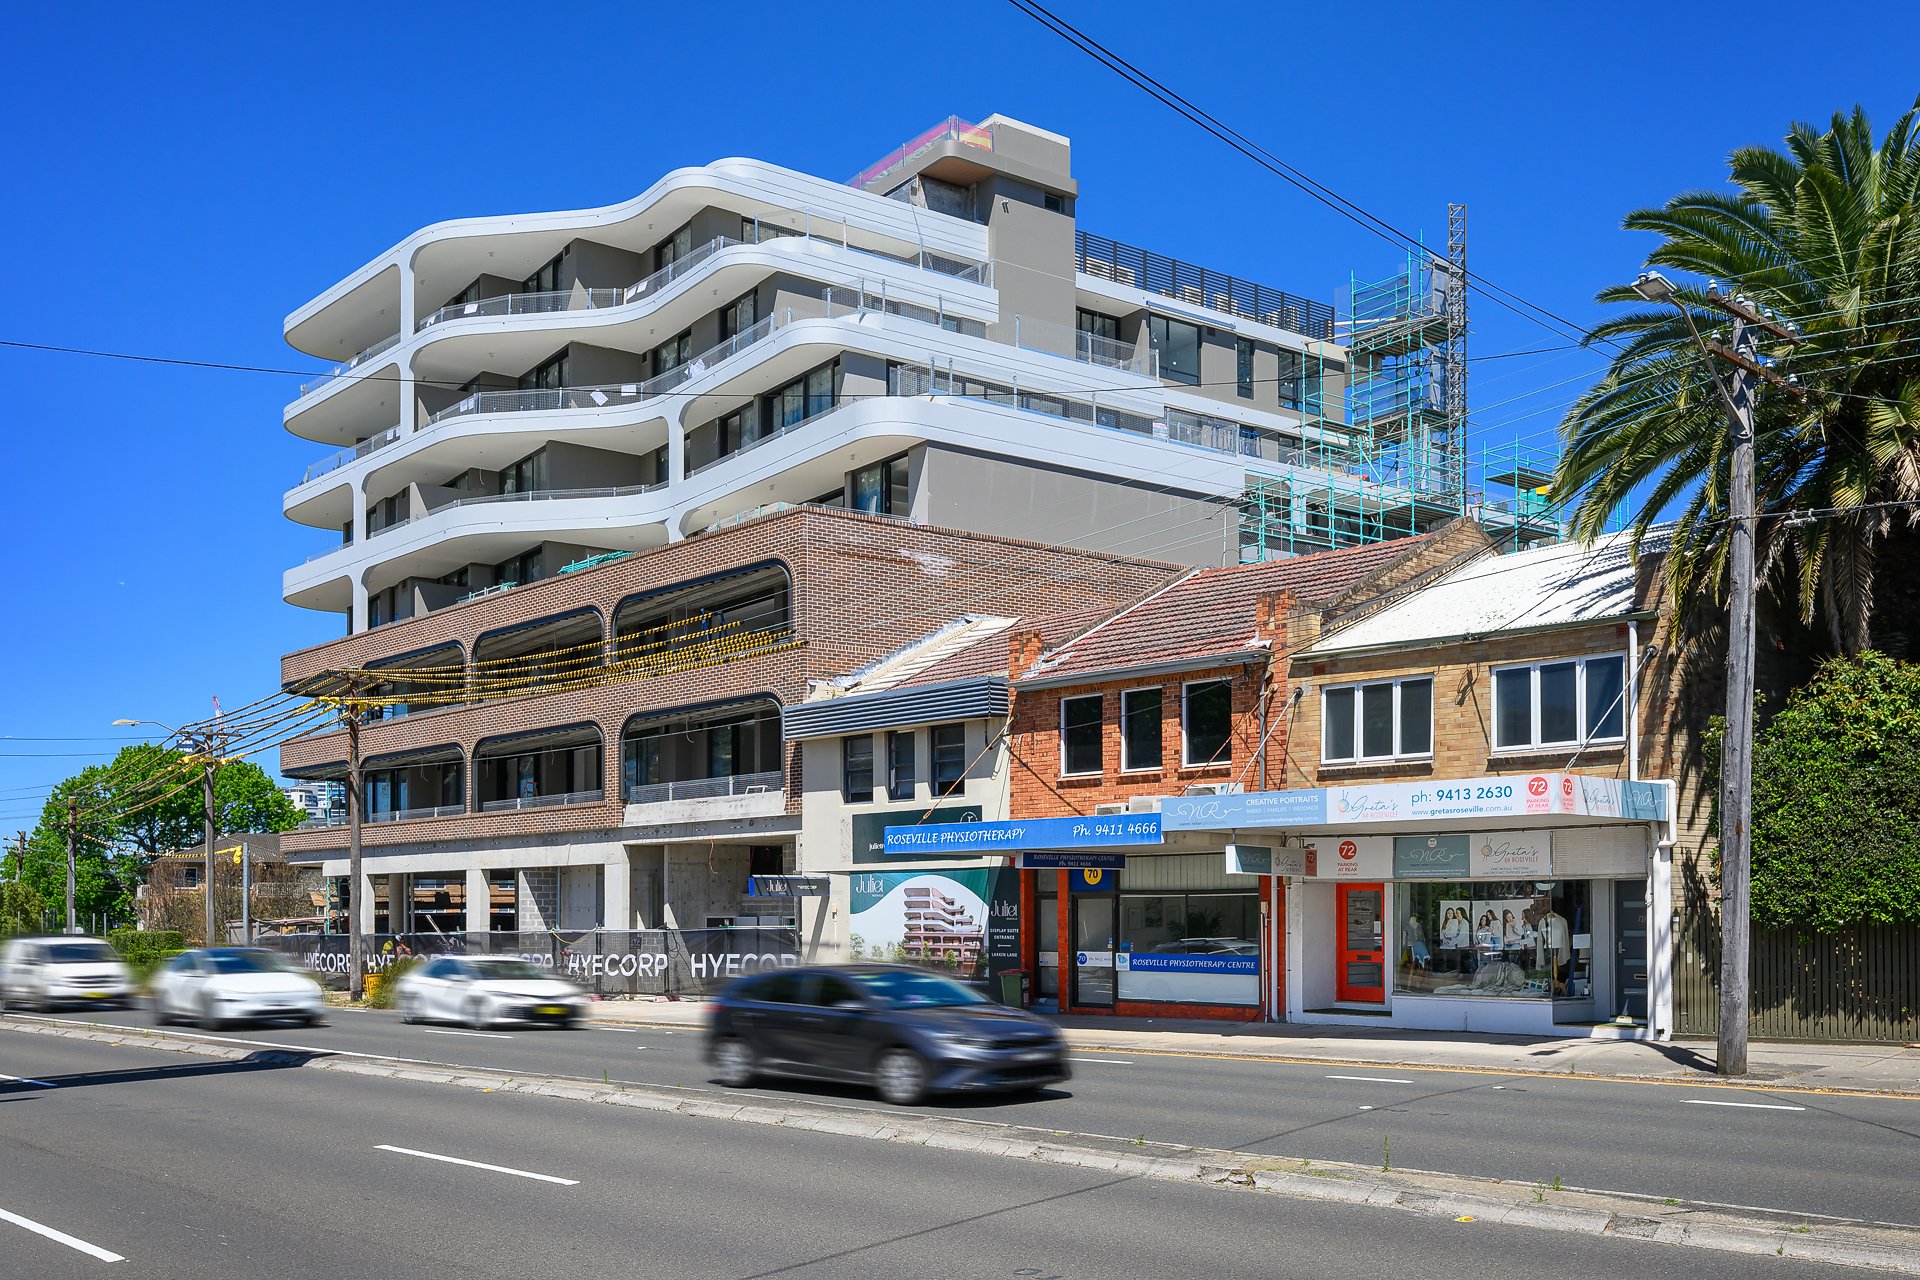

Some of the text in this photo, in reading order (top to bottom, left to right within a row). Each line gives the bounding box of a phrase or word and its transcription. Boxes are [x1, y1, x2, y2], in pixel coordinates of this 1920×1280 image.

[1530, 781, 1546, 792] 72
[1563, 782, 1572, 792] 72
[1245, 795, 1319, 806] CREATIVE PORTRAITS
[1411, 785, 1513, 806] ph: 9413 2630
[1349, 795, 1398, 819] Greta's
[1411, 805, 1513, 816] www.gretasroseville.com.au
[1072, 822, 1157, 837] Ph. 9411 4666
[887, 828, 1026, 845] ROSEVILLE PHYSIOTHERAPY
[1341, 845, 1355, 856] 72
[1493, 841, 1539, 863] Greta's
[1059, 854, 1098, 862] PHYSIOTHERAPY
[1306, 853, 1315, 862] 72
[1088, 869, 1098, 879] 70
[766, 879, 787, 891] Juliet
[856, 874, 884, 894] Juliet
[990, 900, 1018, 917] Juliet
[567, 953, 668, 977] HYECORP
[1132, 958, 1256, 969] ROSEVILLE PHYSIOTHERAPY CENTRE
